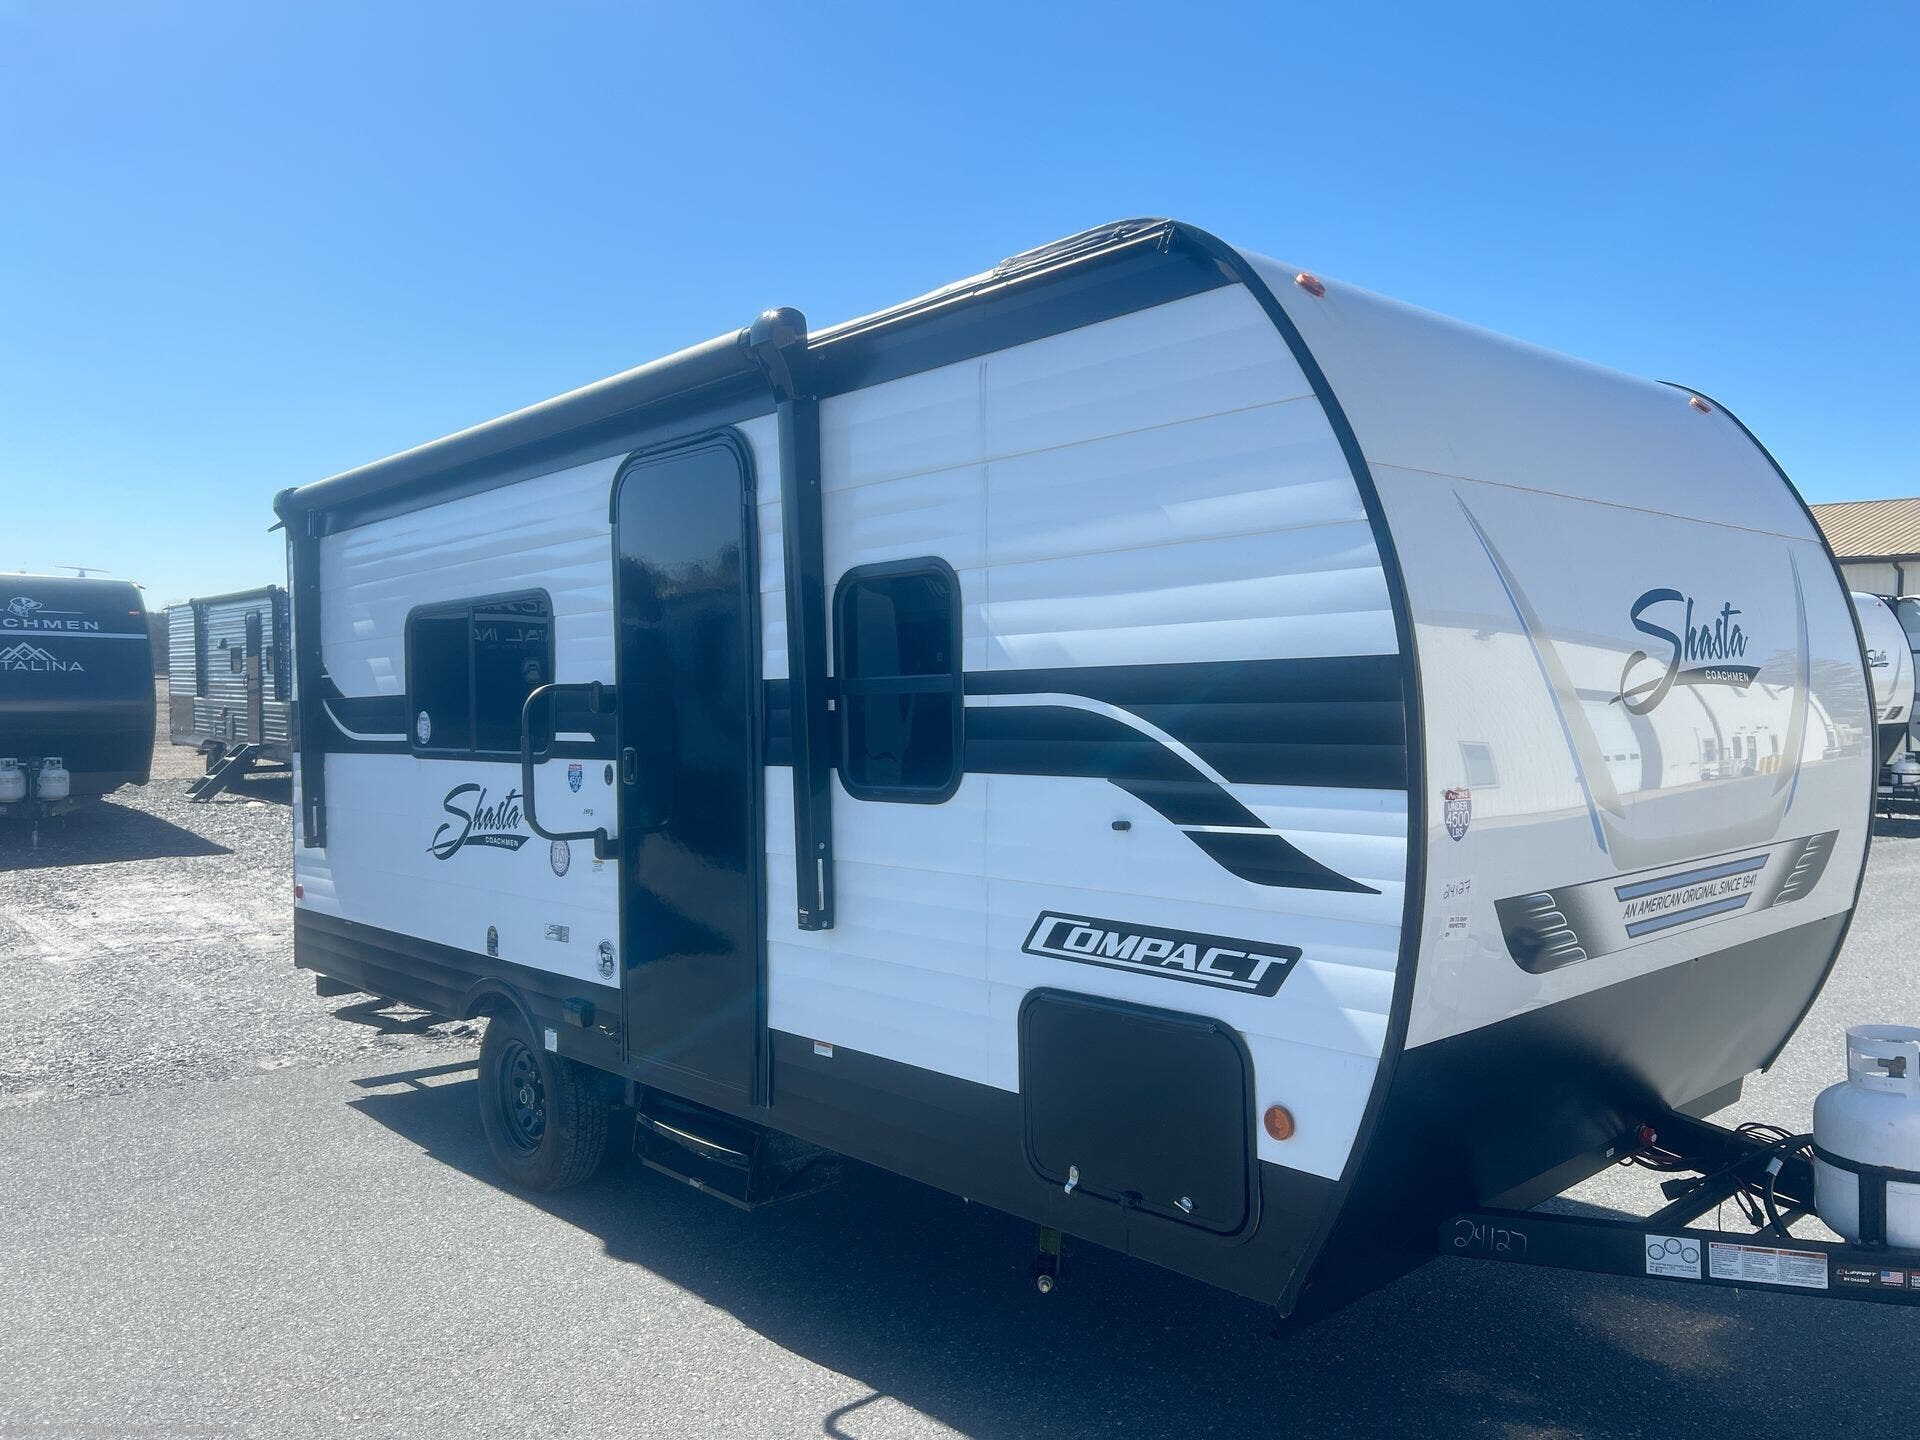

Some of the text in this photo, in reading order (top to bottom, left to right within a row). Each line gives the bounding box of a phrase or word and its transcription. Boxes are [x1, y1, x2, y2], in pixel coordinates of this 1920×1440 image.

[1620, 588, 1748, 715] Shasta
[1705, 669, 1749, 682] COACHMEN
[1446, 811, 1469, 827] 4500
[1447, 801, 1468, 811] UNDER
[432, 783, 524, 860] Shasta
[1452, 828, 1463, 837] LBS
[485, 836, 519, 847] COACHMEN
[1623, 874, 1757, 919] AN AMERICAN ORIGINAL SINCE 1941
[1027, 916, 1288, 989] COMPACT
[1454, 1219, 1527, 1257] 24127
